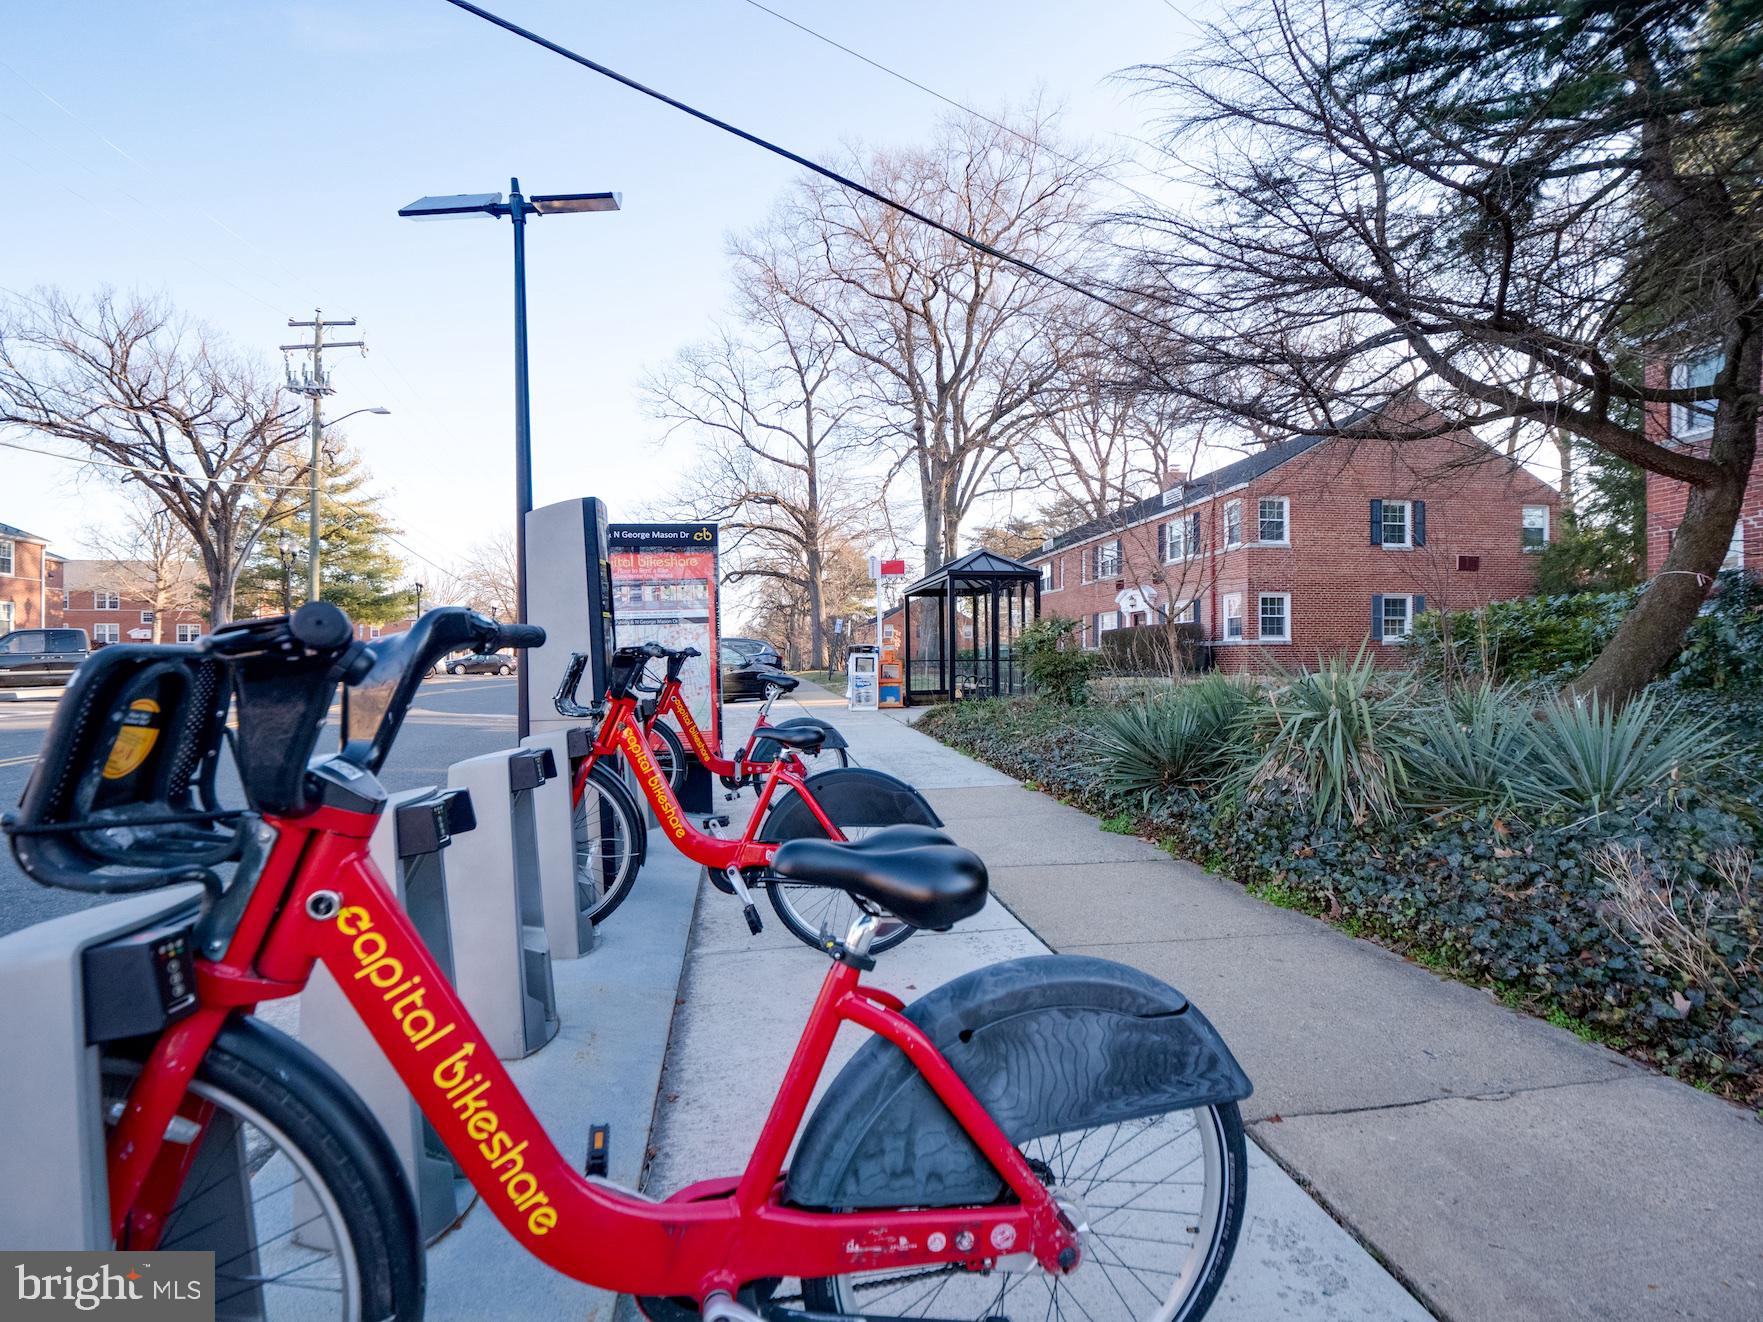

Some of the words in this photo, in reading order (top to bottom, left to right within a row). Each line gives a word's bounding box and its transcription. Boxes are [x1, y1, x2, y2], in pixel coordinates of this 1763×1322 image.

[611, 555, 634, 567] ital
[637, 555, 698, 568] bikeshare
[613, 531, 620, 539] N
[621, 531, 650, 540] George
[652, 531, 678, 539] Mason
[679, 531, 690, 539] Dr
[674, 699, 693, 726] capital
[688, 725, 711, 762] bikeshare
[623, 727, 655, 774] capital
[648, 772, 686, 838] bikeshare
[336, 905, 456, 1051] capital
[433, 1042, 558, 1236] bikeshare
